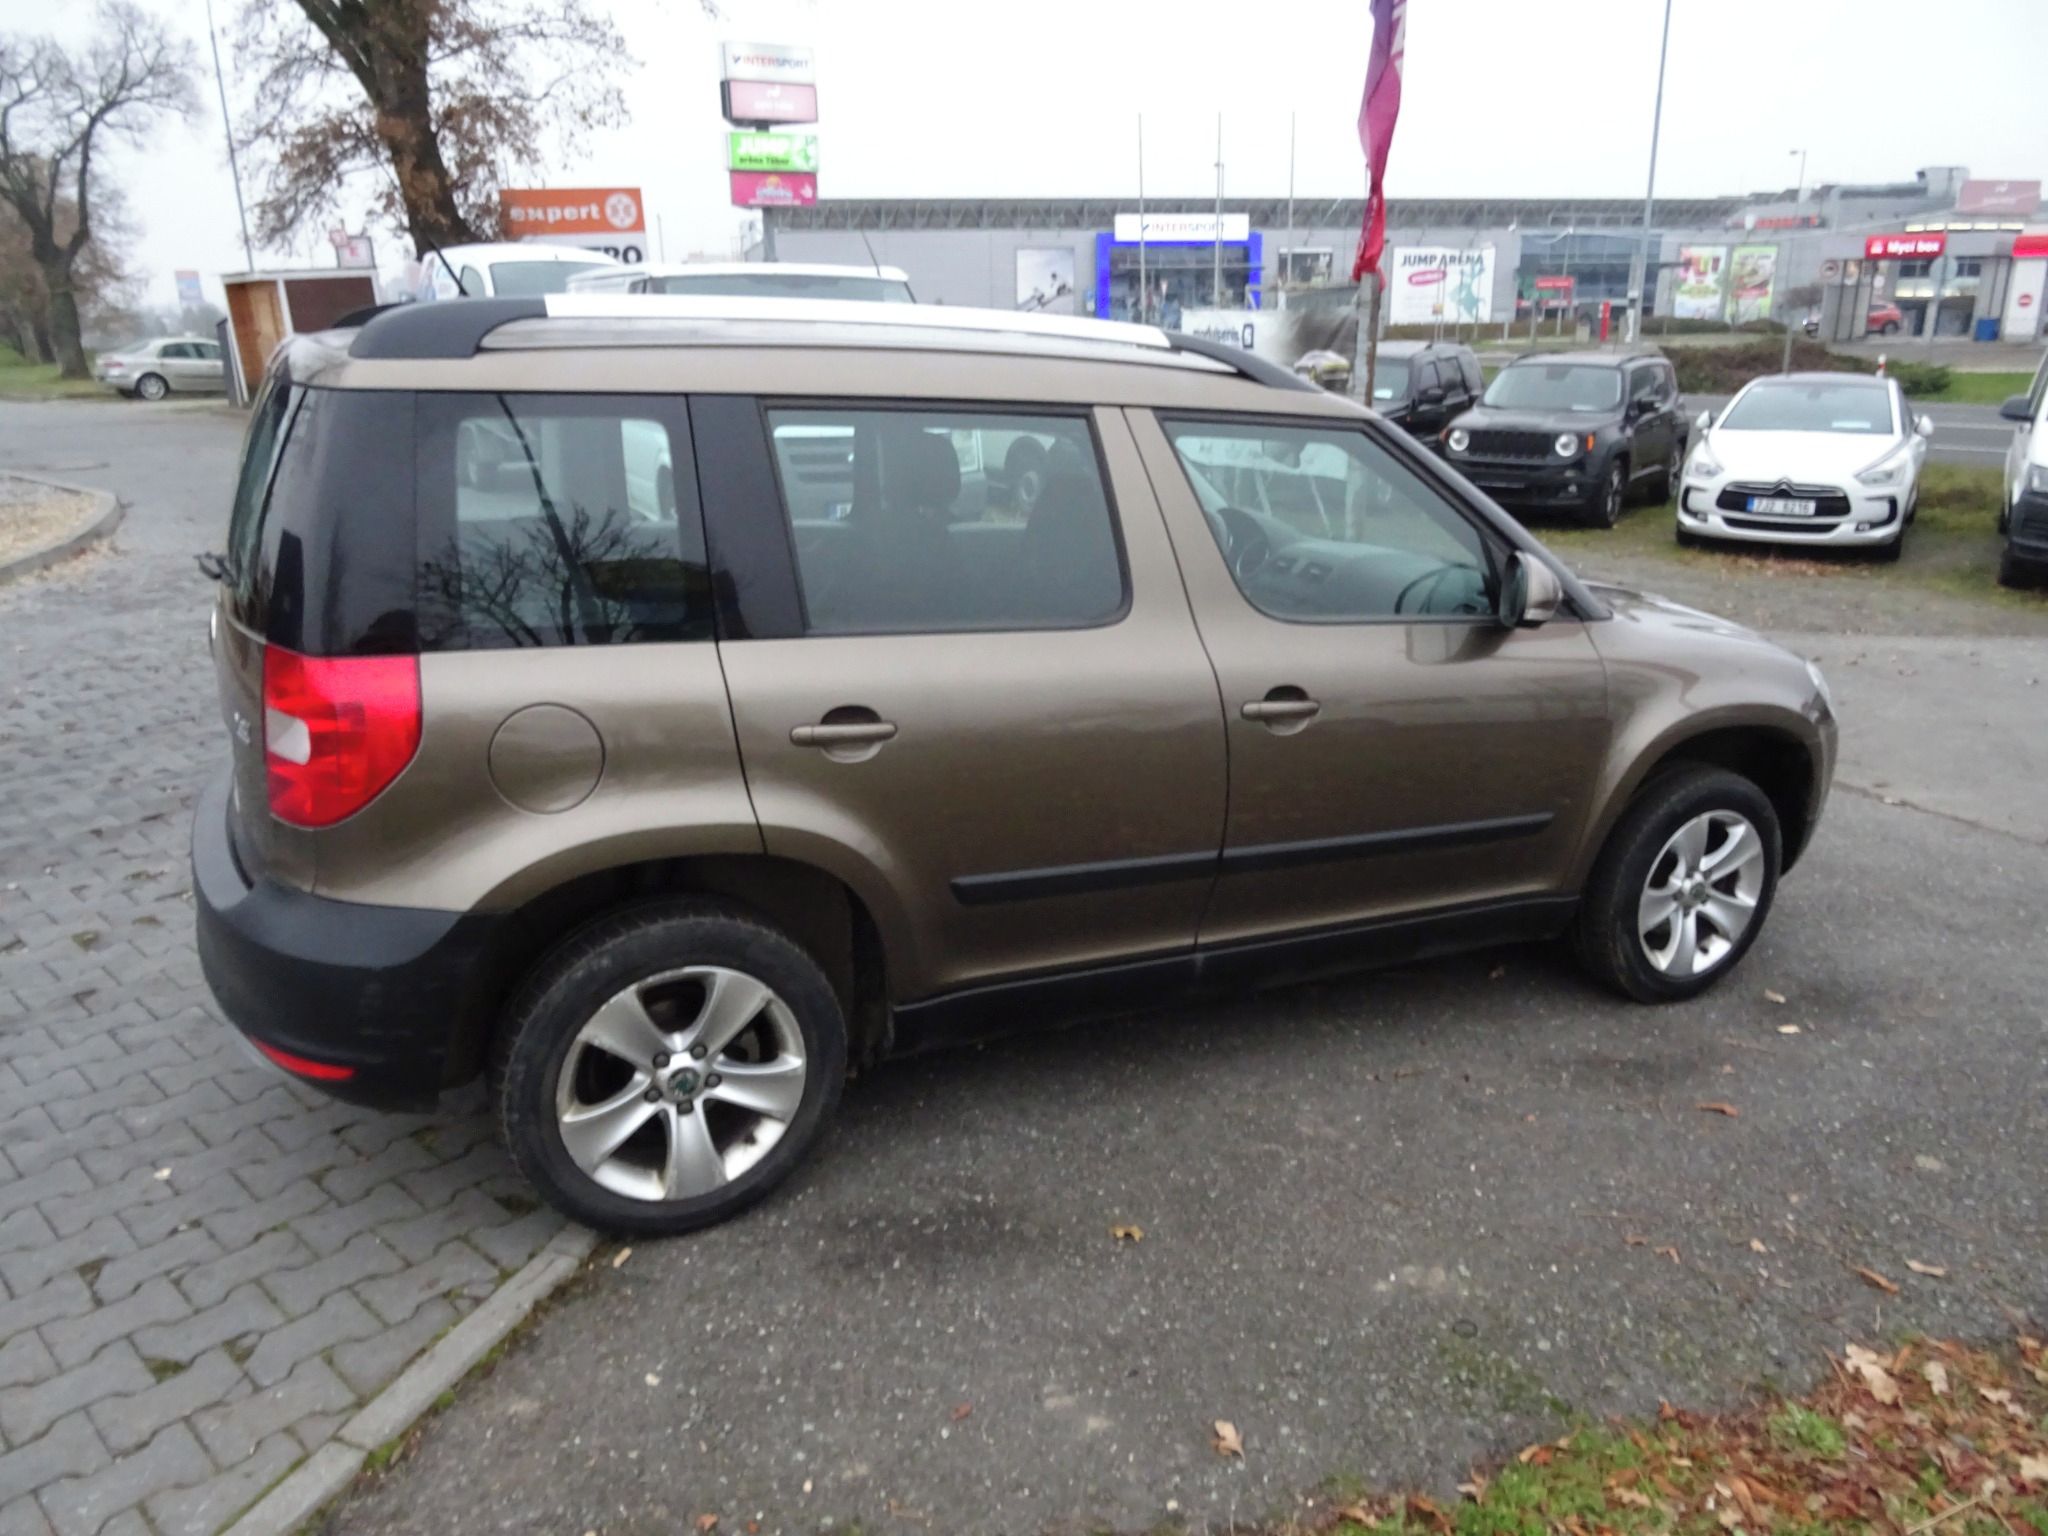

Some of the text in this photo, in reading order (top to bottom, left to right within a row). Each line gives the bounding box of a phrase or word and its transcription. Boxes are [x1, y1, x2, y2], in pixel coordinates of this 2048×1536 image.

[742, 55, 808, 69] INTERSPORT
[510, 202, 600, 224] expert
[1402, 253, 1484, 267] JUMP ARENA
